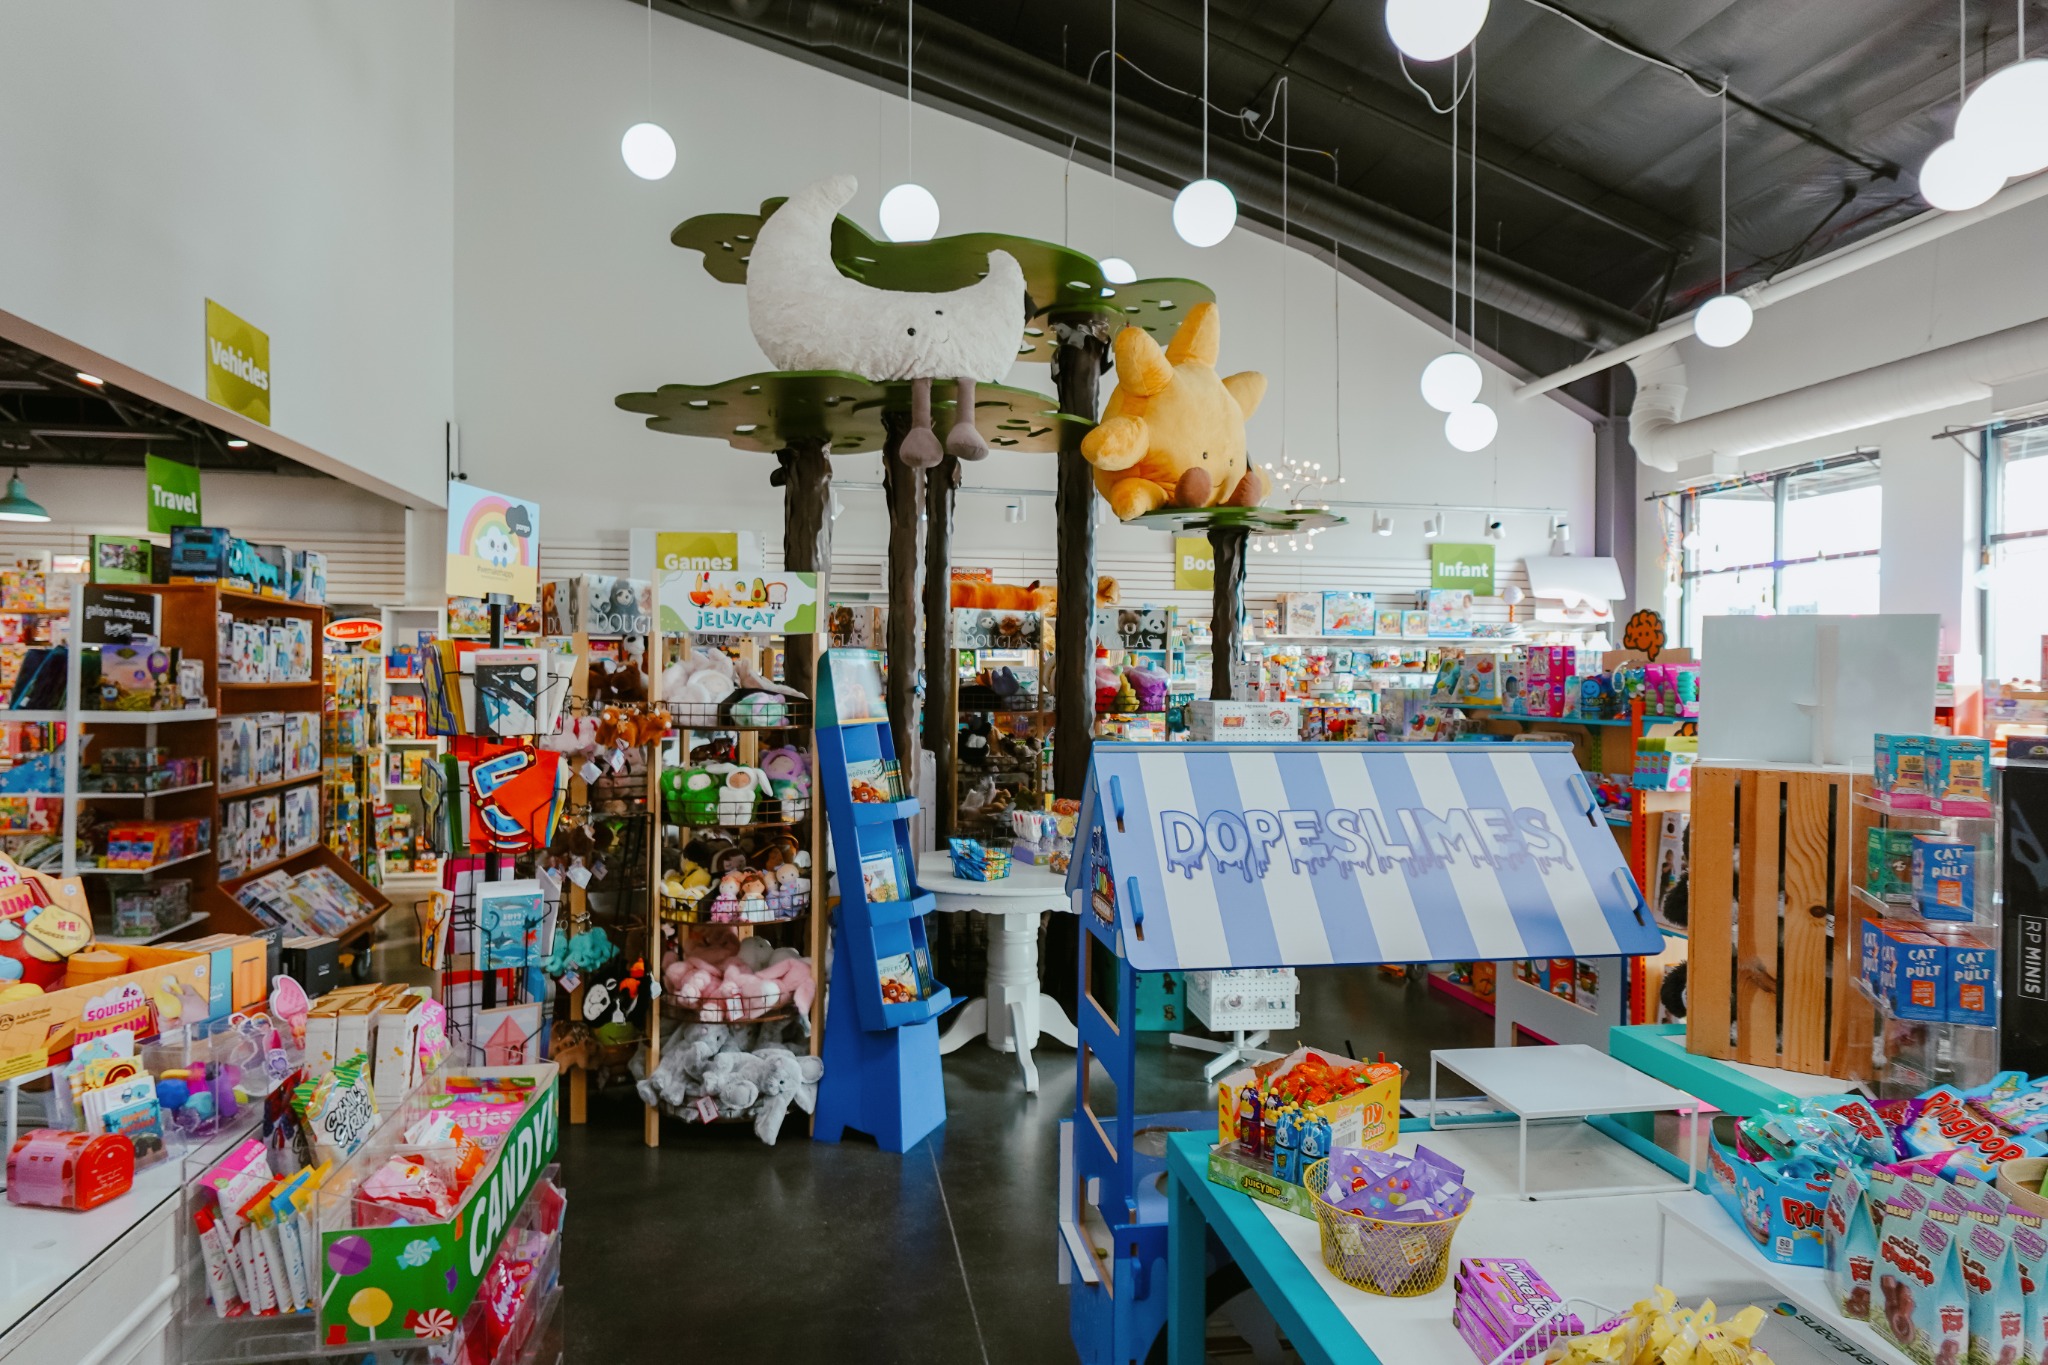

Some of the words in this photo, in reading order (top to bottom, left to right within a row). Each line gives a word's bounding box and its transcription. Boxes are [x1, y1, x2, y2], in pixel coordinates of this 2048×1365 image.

[210, 337, 269, 390] Vehicles
[152, 484, 198, 514] Travel
[664, 553, 733, 571] Games
[1438, 562, 1489, 578] Infant
[952, 567, 987, 575] CHECKERS
[965, 633, 1032, 648] DOUGLAS
[1160, 808, 1575, 884] DOPESLIMES
[1934, 848, 1963, 860] CAT
[1931, 865, 1969, 878] PULT
[2025, 920, 2042, 944] RP
[1908, 948, 1937, 961] CAT
[1957, 952, 1986, 965] CAT
[1906, 965, 1941, 979] PULT
[1954, 969, 1991, 982] PULT
[2024, 946, 2042, 994] MINIS
[87, 998, 142, 1022] SQUISHY
[469, 1092, 555, 1277] CANDY!
[1243, 1176, 1266, 1193] JUICY
[1265, 1184, 1282, 1197] DROP
[1886, 1204, 1913, 1219] NEW!
[1928, 1208, 1959, 1224] NEW!
[1498, 1262, 1536, 1296] Mike
